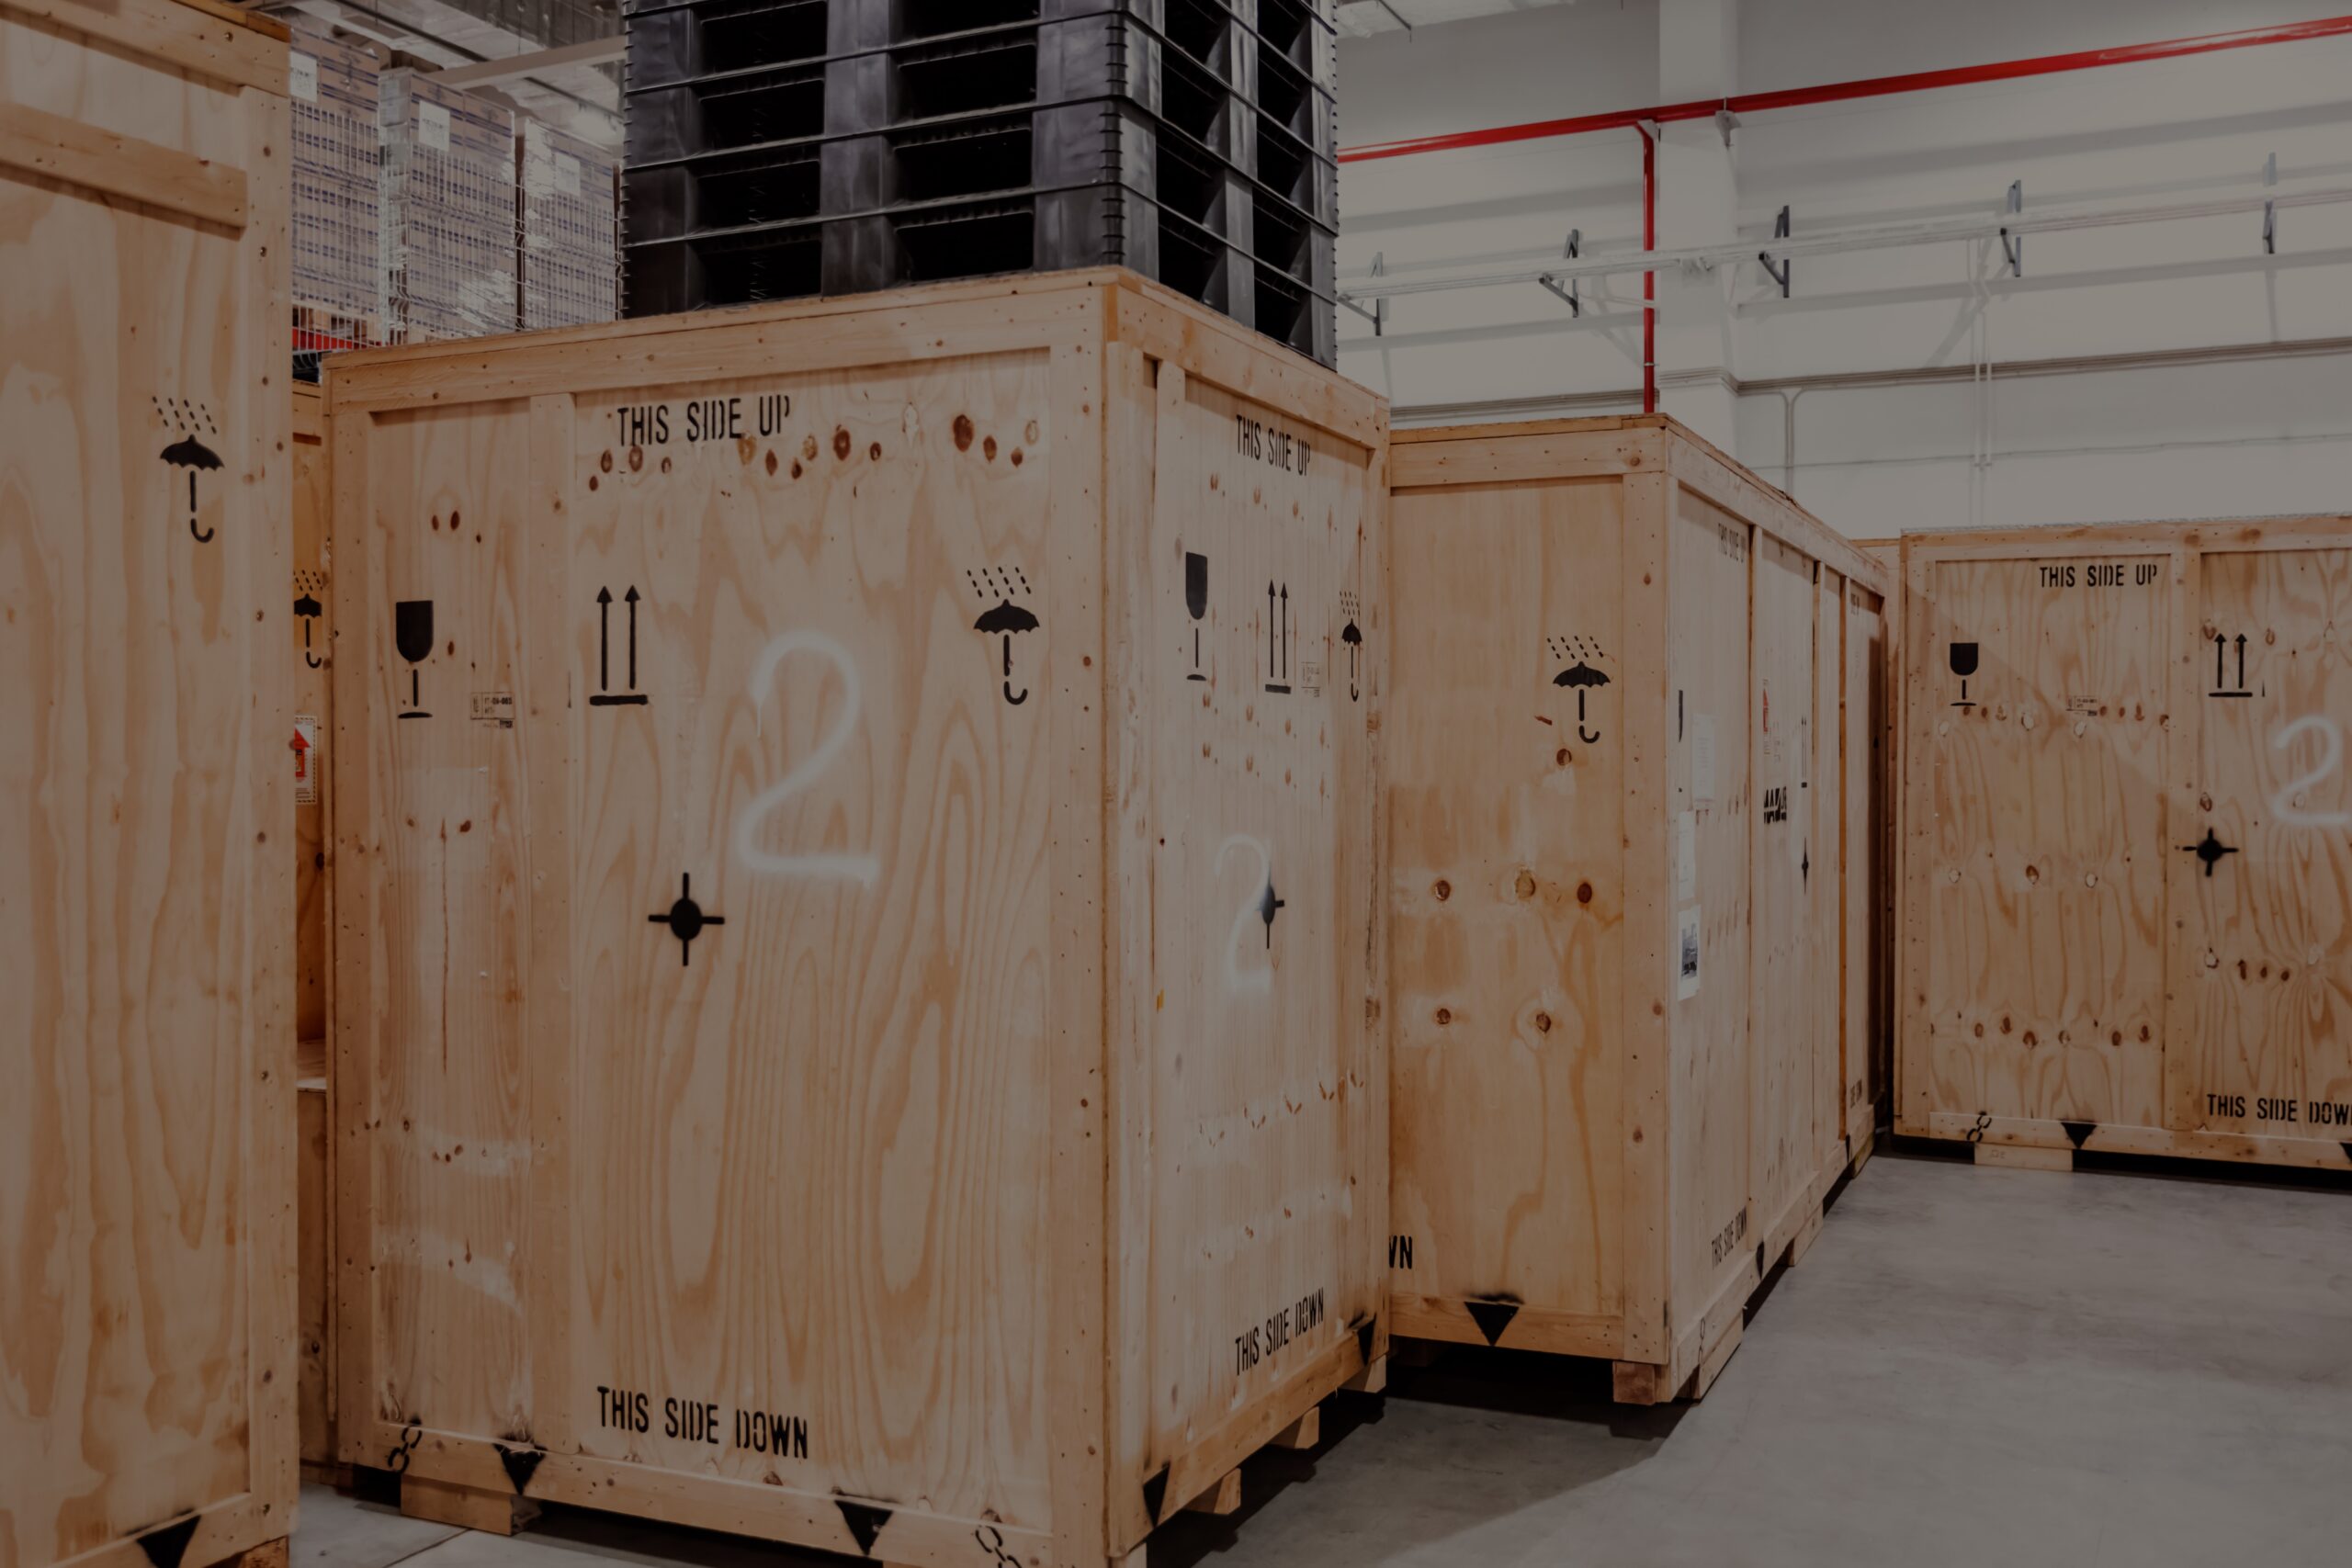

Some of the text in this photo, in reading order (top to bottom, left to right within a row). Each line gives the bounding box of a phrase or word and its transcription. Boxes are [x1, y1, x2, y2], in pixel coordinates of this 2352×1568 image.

[617, 395, 790, 446] THIS SIDE UP
[1237, 414, 1310, 476] THIS SIDE UP
[2040, 564, 2157, 588] THIS SIDE UP
[738, 628, 880, 887] 2
[2273, 715, 2352, 828] 2
[1214, 833, 1270, 992] 2
[2207, 1094, 2352, 1126] THIS SIDE DOW
[1235, 1286, 1323, 1376] THIS SIDE DOWN
[597, 1385, 808, 1460] THIS SIDE DOWN
